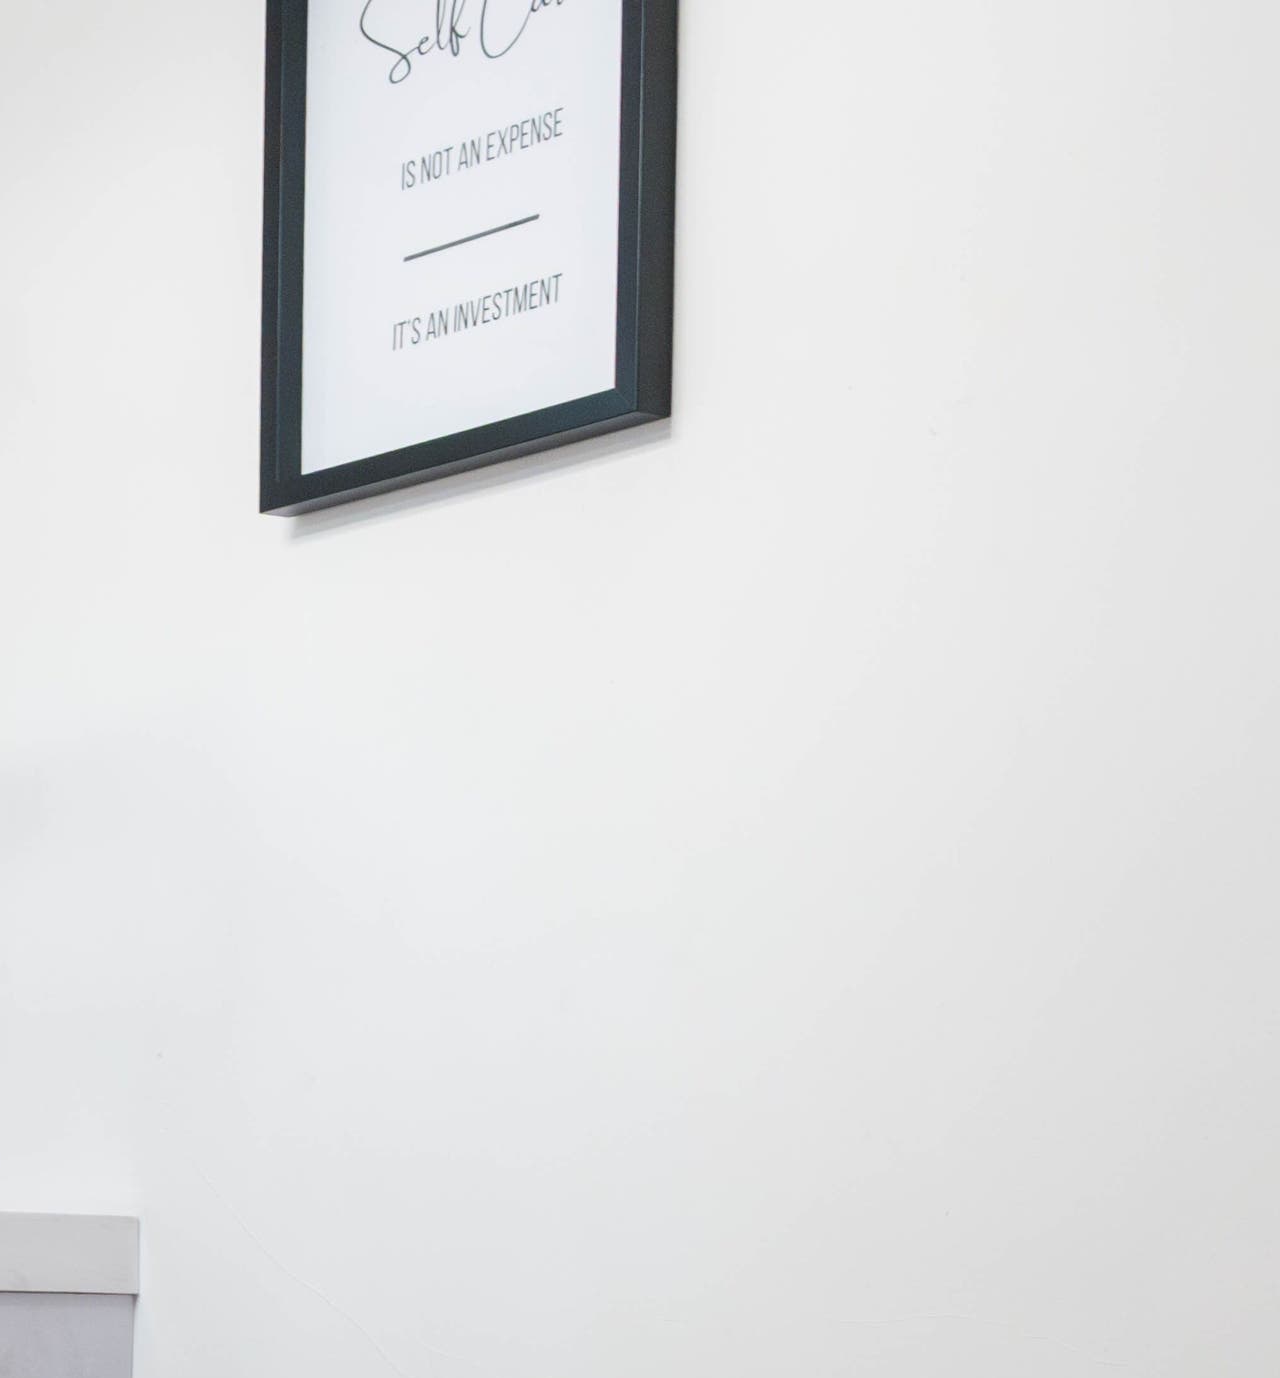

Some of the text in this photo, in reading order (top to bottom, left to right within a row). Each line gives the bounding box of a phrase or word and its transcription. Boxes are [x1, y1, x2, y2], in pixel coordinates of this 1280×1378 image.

[400, 107, 564, 191] IS NOT AN EXPENSE
[392, 273, 563, 351] IT'S AN INVESTMENT
